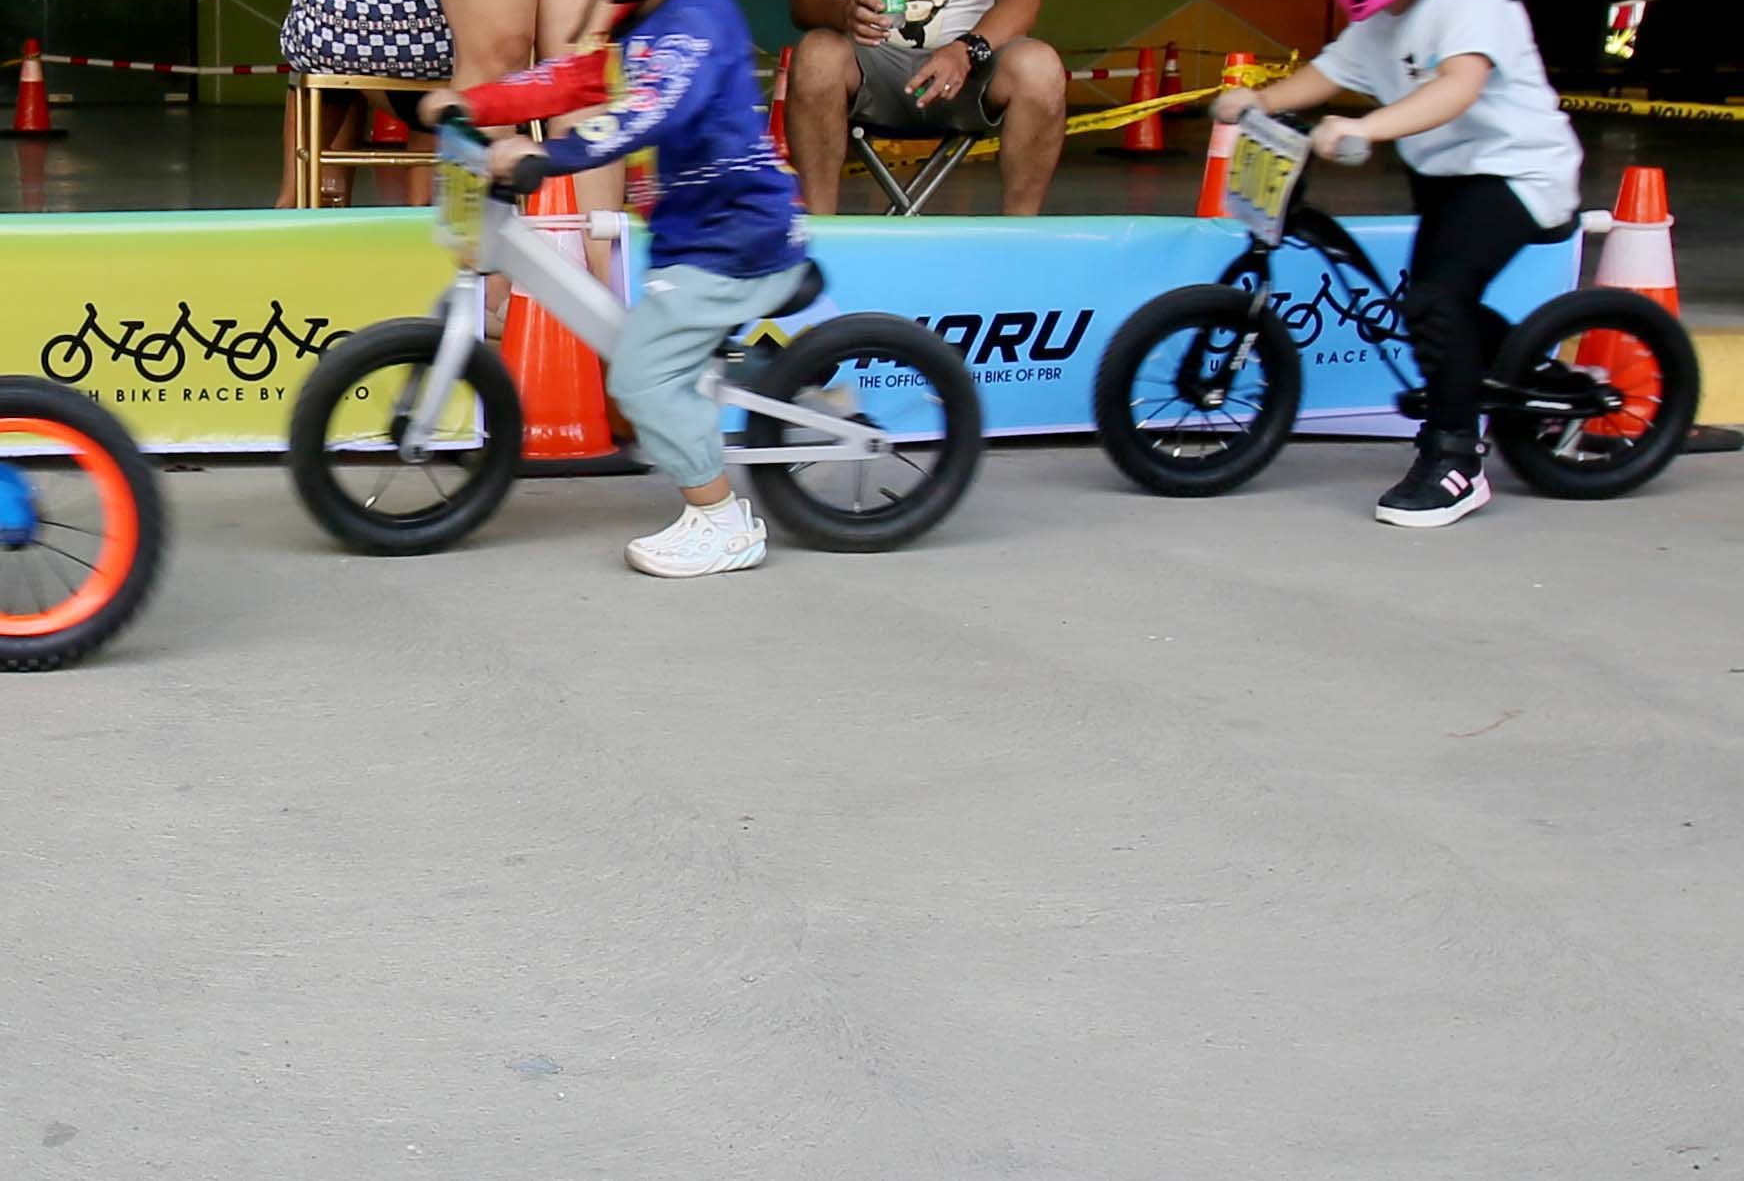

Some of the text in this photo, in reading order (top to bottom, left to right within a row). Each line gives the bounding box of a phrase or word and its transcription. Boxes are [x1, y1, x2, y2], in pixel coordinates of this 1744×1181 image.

[1315, 349, 1368, 365] RACE
[859, 375, 881, 388] THE
[984, 368, 1012, 383] BIKE
[1016, 368, 1034, 382] OF
[1037, 367, 1062, 381] PBR
[116, 387, 286, 402] BIKE RACE BY
